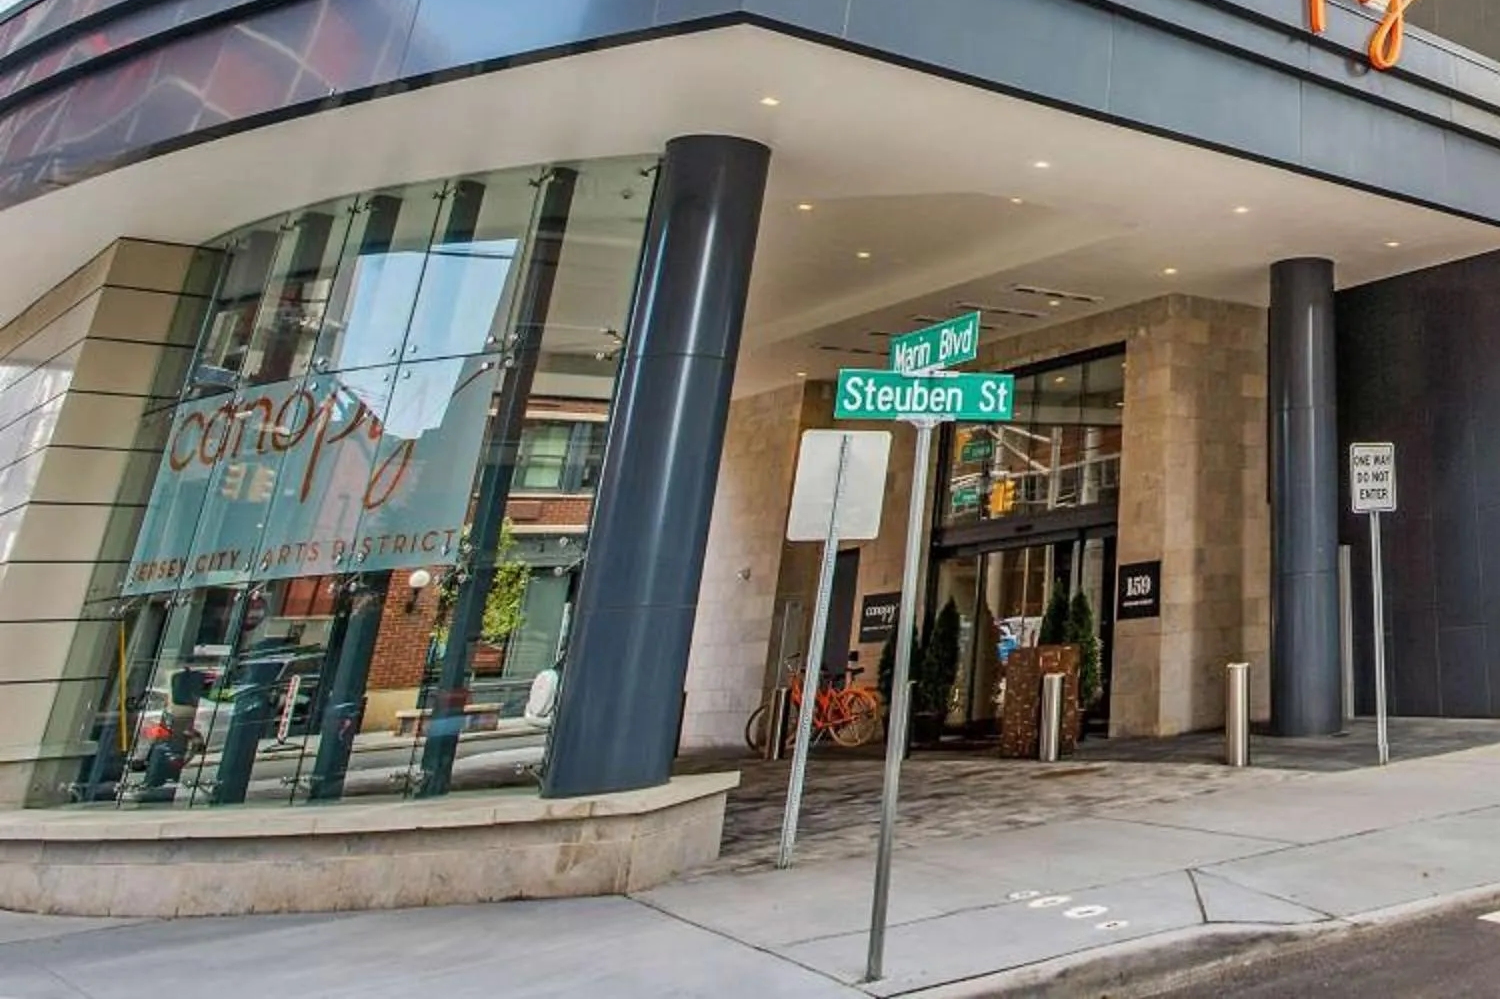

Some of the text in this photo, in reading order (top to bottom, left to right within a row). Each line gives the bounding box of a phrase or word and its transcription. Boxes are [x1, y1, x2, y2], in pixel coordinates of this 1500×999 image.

[894, 321, 973, 373] Marin Blvd
[843, 376, 1009, 413] Steuben St
[1353, 454, 1392, 467] ONE WAY
[1357, 470, 1390, 484] DO NOT
[1360, 488, 1389, 500] ENTER
[195, 549, 241, 573] CITY
[261, 541, 320, 567] ARTS
[331, 529, 457, 561] DISTRICT
[1126, 574, 1151, 597] 159
